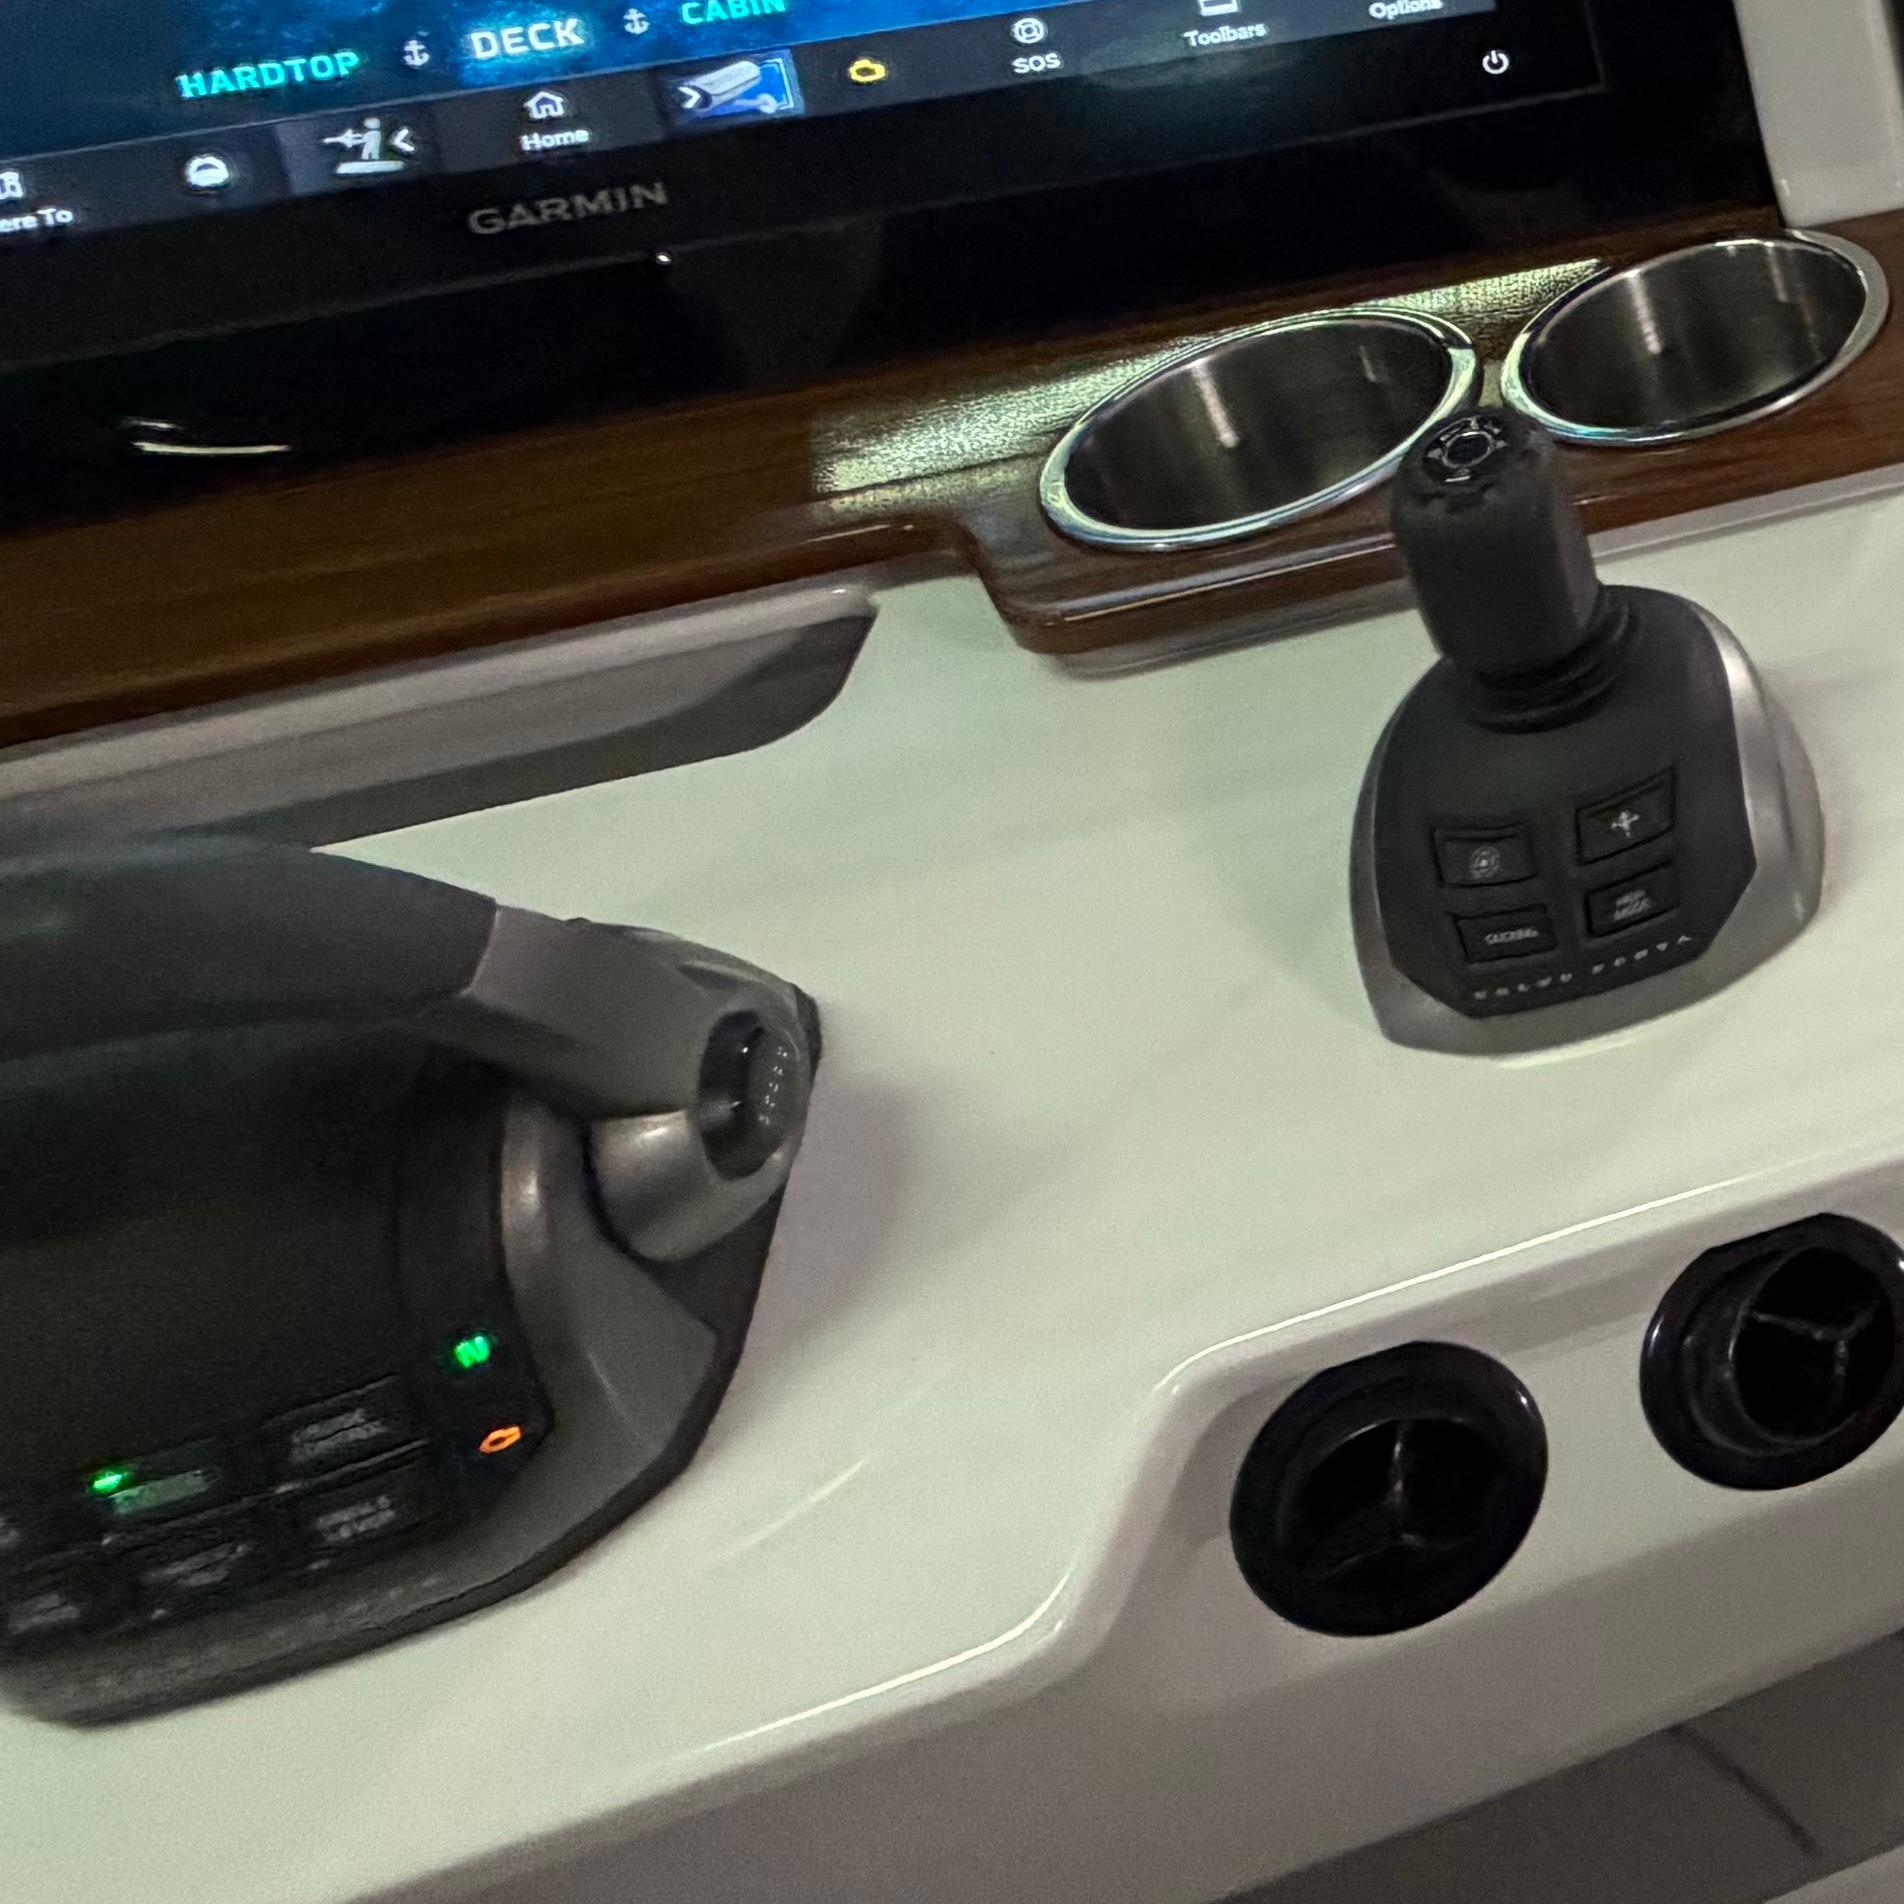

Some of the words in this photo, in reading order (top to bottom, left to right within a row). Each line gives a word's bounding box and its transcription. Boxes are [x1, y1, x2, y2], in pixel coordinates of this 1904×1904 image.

[470, 17, 585, 61] DECK
[1183, 20, 1267, 48] Toolbars
[177, 49, 361, 100] HARDTOP
[1011, 52, 1063, 75] SOS
[519, 128, 591, 152] Home
[467, 182, 669, 235] GARMIN
